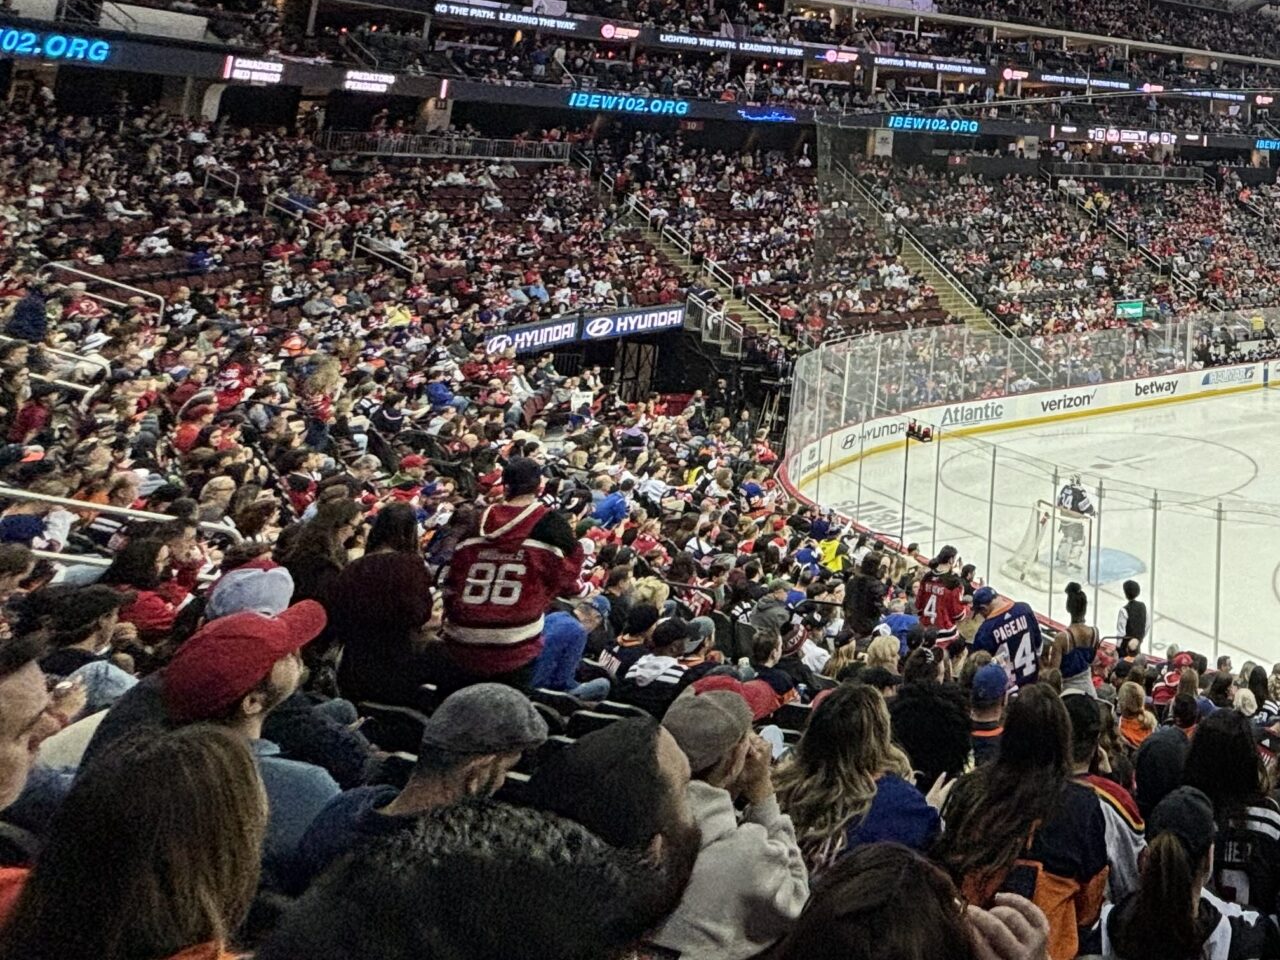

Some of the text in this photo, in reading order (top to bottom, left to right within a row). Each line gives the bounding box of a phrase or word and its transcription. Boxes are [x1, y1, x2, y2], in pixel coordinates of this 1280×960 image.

[450, 5, 469, 16] THE
[499, 13, 538, 25] LEADING
[539, 19, 556, 28] THE
[660, 34, 698, 45] LIGHTING
[700, 38, 715, 47] THE
[739, 43, 772, 53] LEADING
[773, 45, 787, 55] THE
[568, 92, 689, 115] IBEW102.ORG
[888, 116, 979, 132] IBEW102.ORG
[616, 310, 683, 332] HYUNDAI
[515, 322, 576, 350] HYUNDAI
[1135, 380, 1179, 396] betway
[942, 402, 1004, 426] Atlantic
[1041, 393, 1091, 412] verizon
[858, 422, 906, 441] HYUNDA
[462, 563, 527, 605] 86
[924, 595, 937, 624] 4
[993, 615, 1028, 644] PAGEAU
